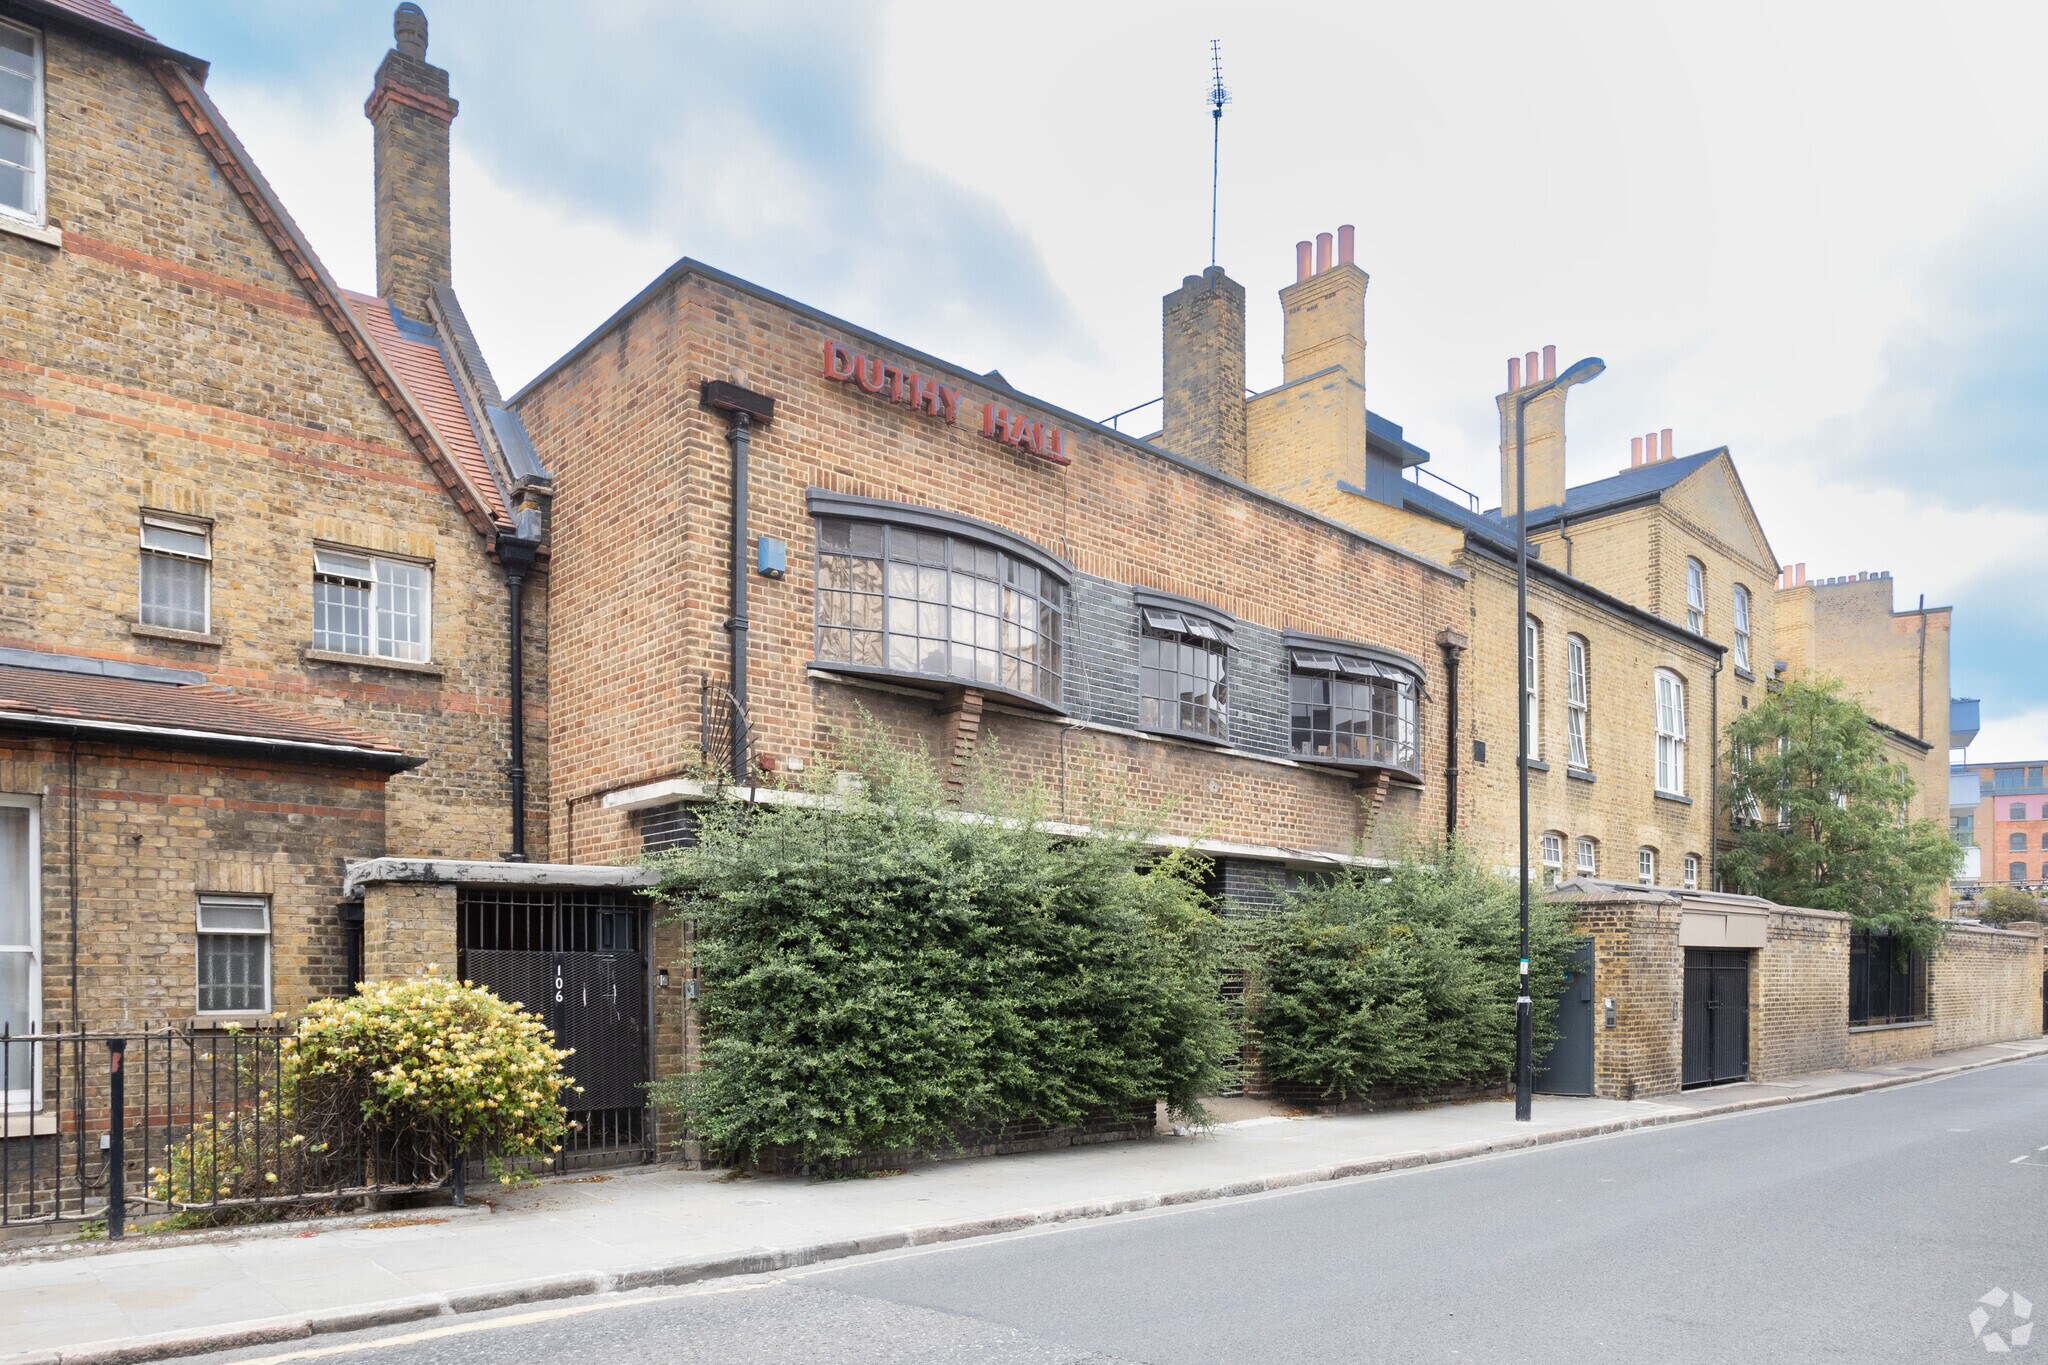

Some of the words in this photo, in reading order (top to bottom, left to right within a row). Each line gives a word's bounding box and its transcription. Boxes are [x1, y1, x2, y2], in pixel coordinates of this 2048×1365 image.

[823, 339, 964, 425] DUTHY
[982, 402, 1071, 465] HALL
[555, 964, 564, 1003] 106
